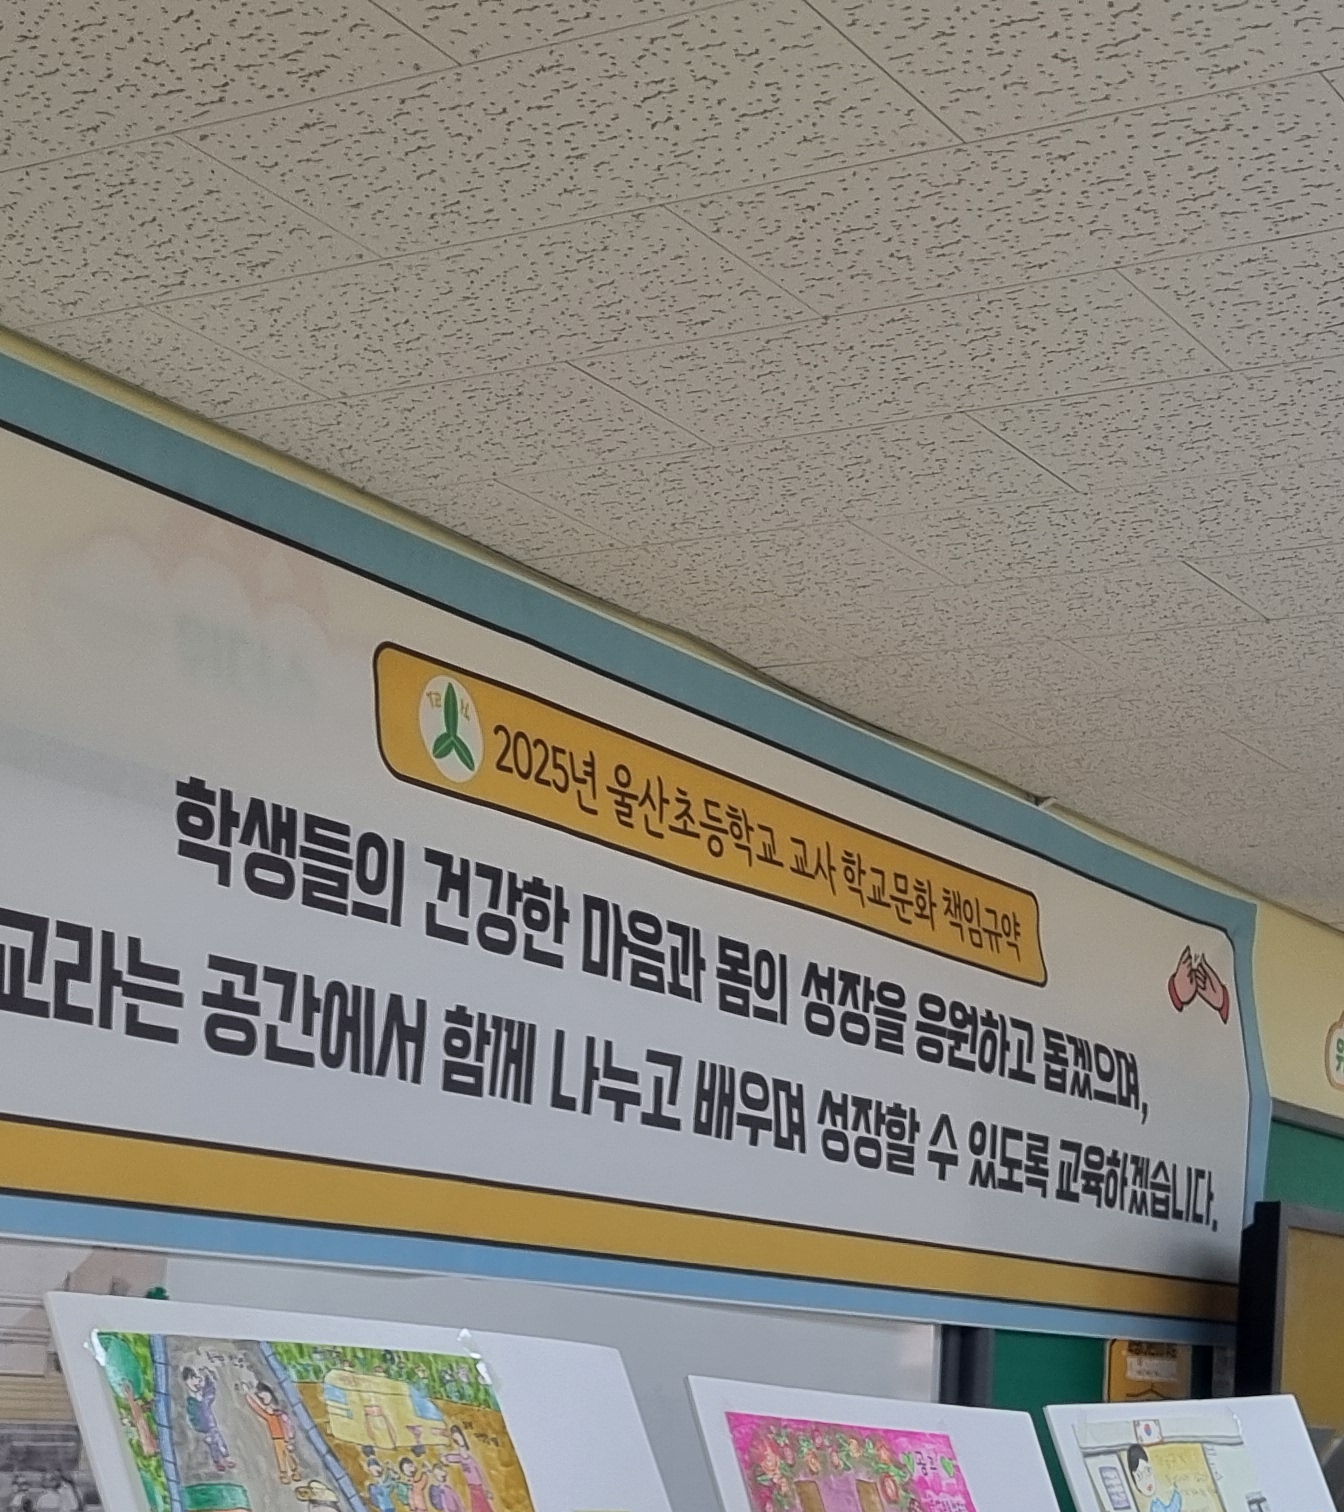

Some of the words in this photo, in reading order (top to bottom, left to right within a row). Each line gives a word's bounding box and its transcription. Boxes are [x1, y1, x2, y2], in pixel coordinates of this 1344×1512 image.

[175, 776, 406, 928] 학생들의
[423, 845, 570, 969] 건강한
[582, 893, 706, 1003] 마음과
[717, 935, 788, 1025] 몸의
[799, 969, 908, 1054] 성장을
[916, 992, 1037, 1086] 응원하고
[1044, 1028, 1151, 1125] 돕겠으며,
[494, 723, 598, 815] 2025년
[606, 763, 783, 872] 울산초등학교
[789, 835, 836, 896] 교사
[841, 851, 937, 932] 학교문화
[942, 889, 1022, 963] 책임규약
[201, 953, 428, 1085] 공간에서
[442, 1005, 536, 1105] 함께
[551, 1028, 684, 1132] 나누고
[695, 1058, 806, 1154] 배우며
[816, 1090, 920, 1177] 성장할
[928, 1110, 958, 1182] 수
[968, 1119, 1050, 1200] 있도록
[1055, 1138, 1218, 1232] 교육하겠습니다.
